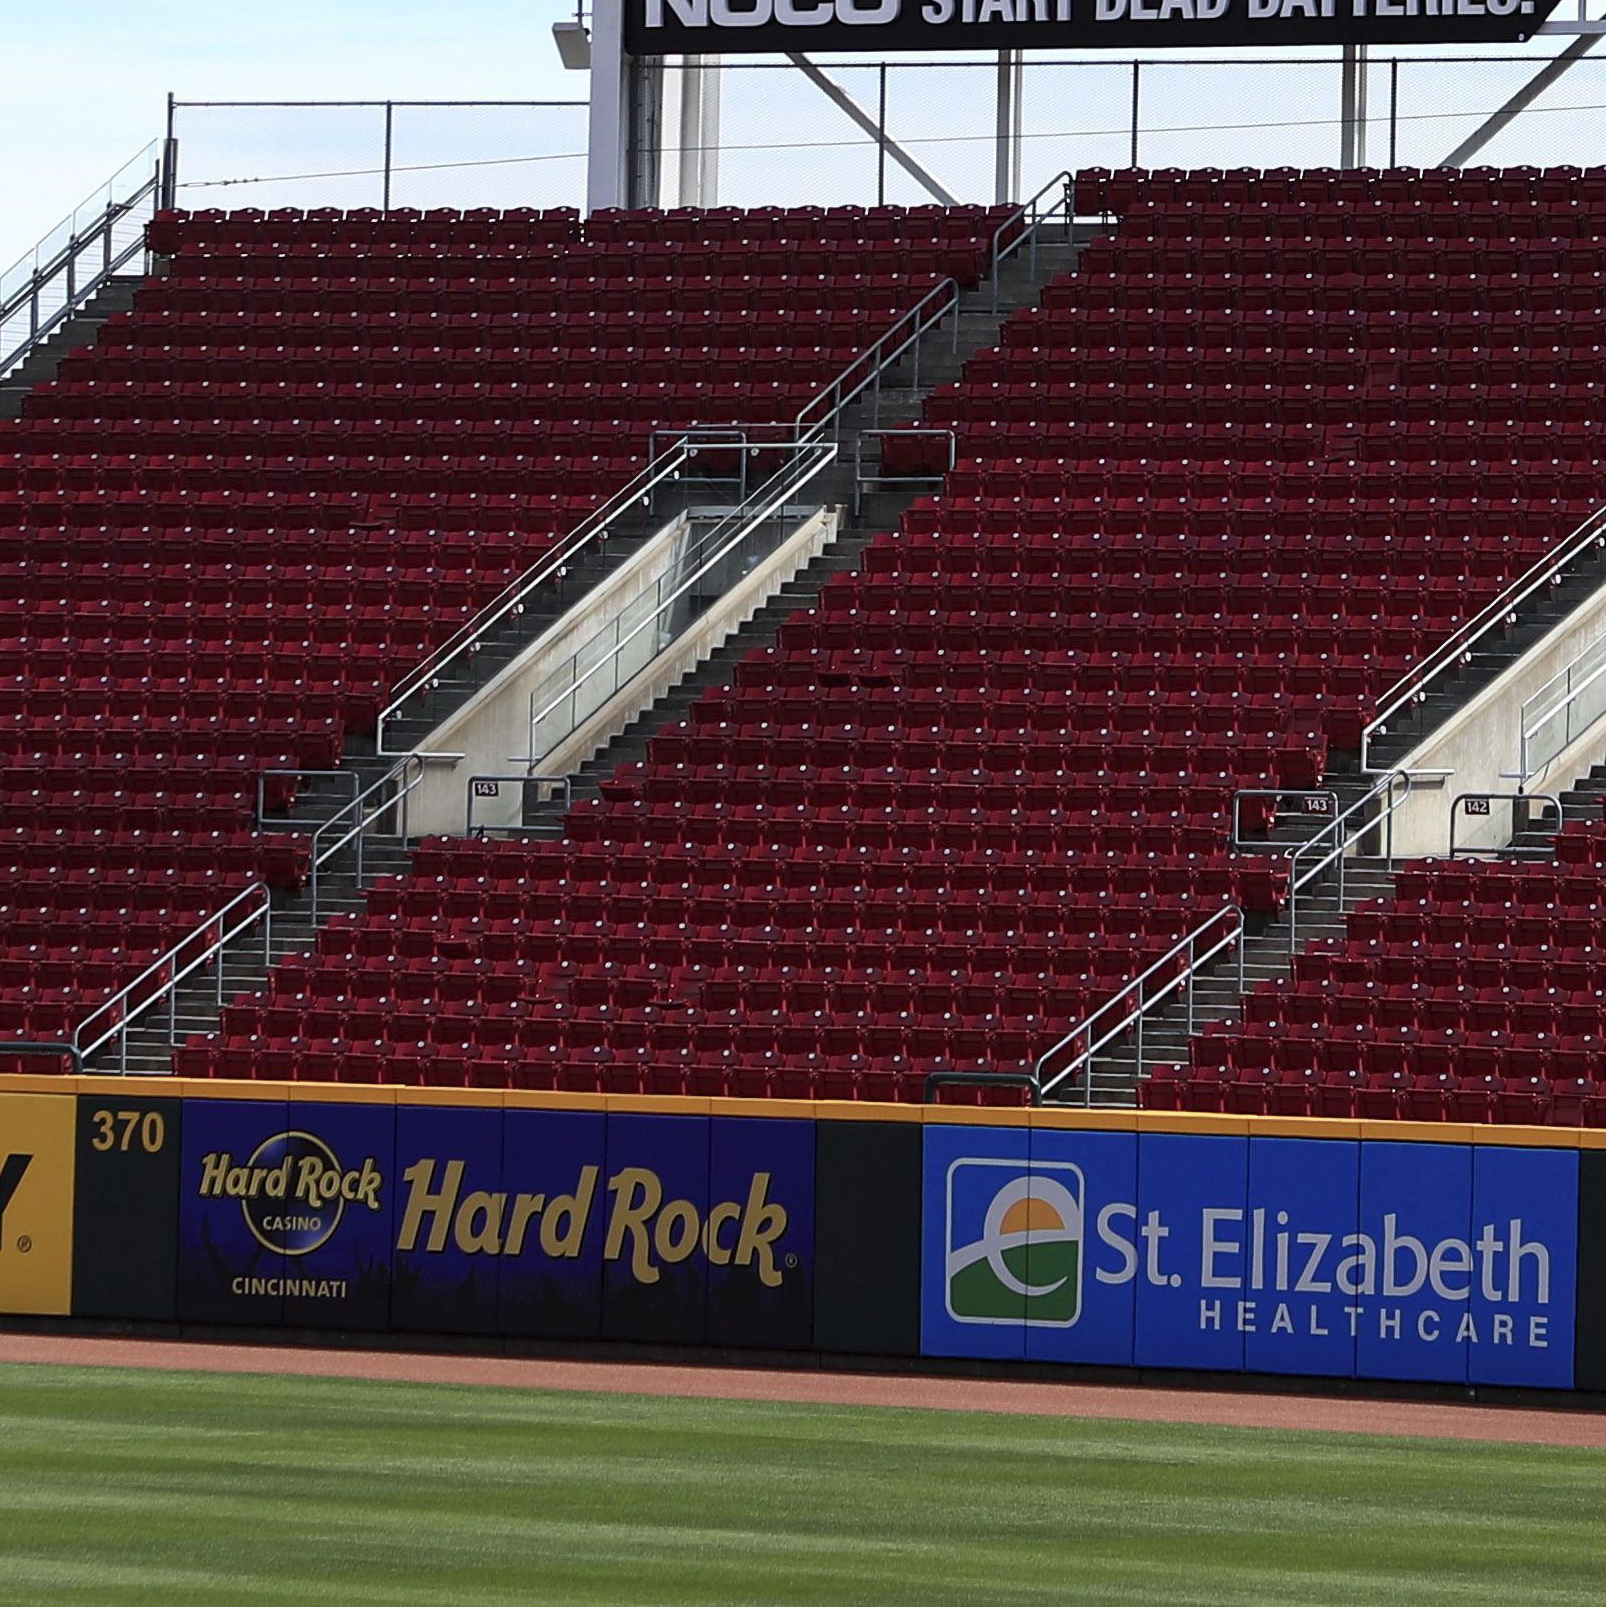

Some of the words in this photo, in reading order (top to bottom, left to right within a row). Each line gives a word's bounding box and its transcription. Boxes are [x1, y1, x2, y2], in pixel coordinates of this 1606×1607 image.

[477, 784, 497, 795] 143
[1307, 799, 1327, 811] 143
[1467, 802, 1487, 813] 142
[92, 1111, 164, 1153] 370
[200, 1152, 291, 1198] Hard
[296, 1155, 383, 1210] Rock
[263, 1215, 321, 1232] CASINO
[396, 1159, 599, 1257] Hard
[604, 1166, 787, 1287] Rock
[1096, 1203, 1181, 1288] St.
[1201, 1207, 1550, 1304] Elizabeth
[232, 1277, 347, 1298] CINCINNATI
[1200, 1300, 1549, 1348] HEALTHCARE
